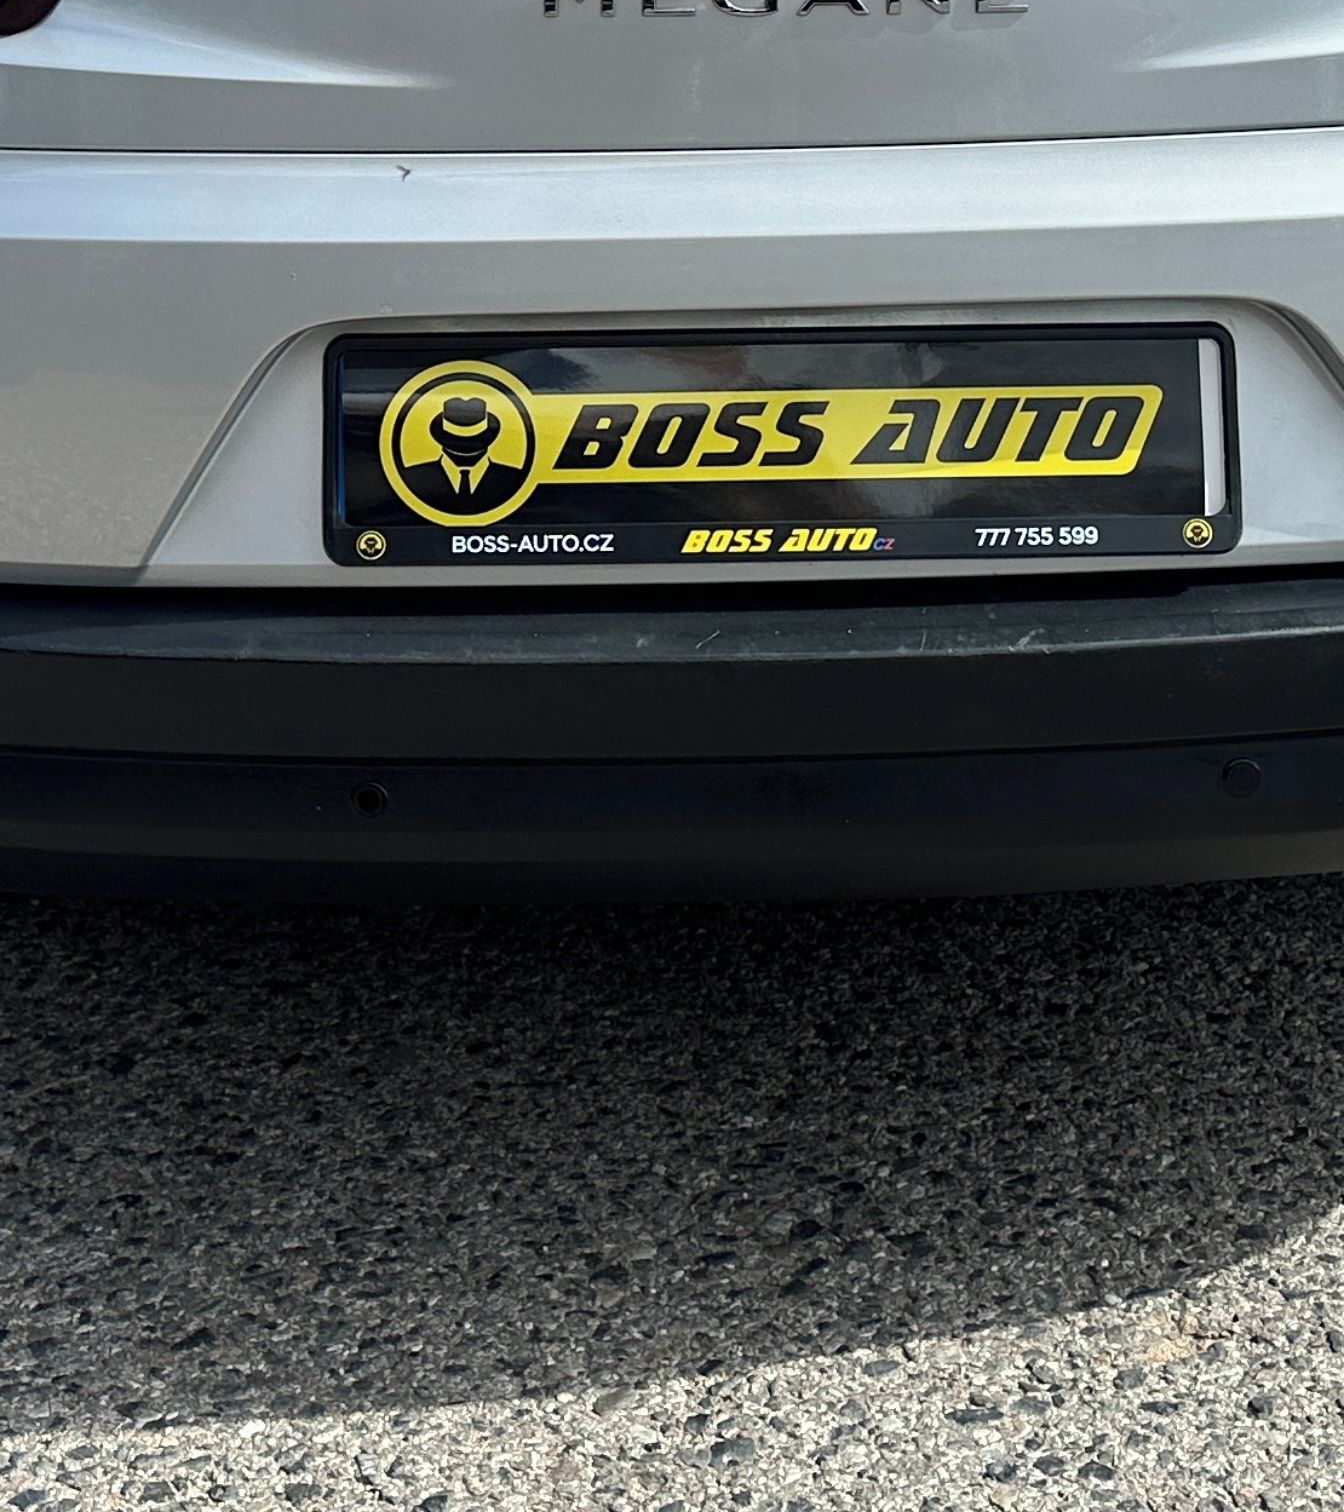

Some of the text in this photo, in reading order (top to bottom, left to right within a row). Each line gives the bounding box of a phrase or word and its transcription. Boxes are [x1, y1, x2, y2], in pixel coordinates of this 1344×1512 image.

[552, 396, 1145, 470] BOSS AUTO
[452, 533, 614, 554] BOSS-AUTO.CZ
[681, 528, 774, 554] BOSS
[975, 526, 1099, 547] 777 755 599
